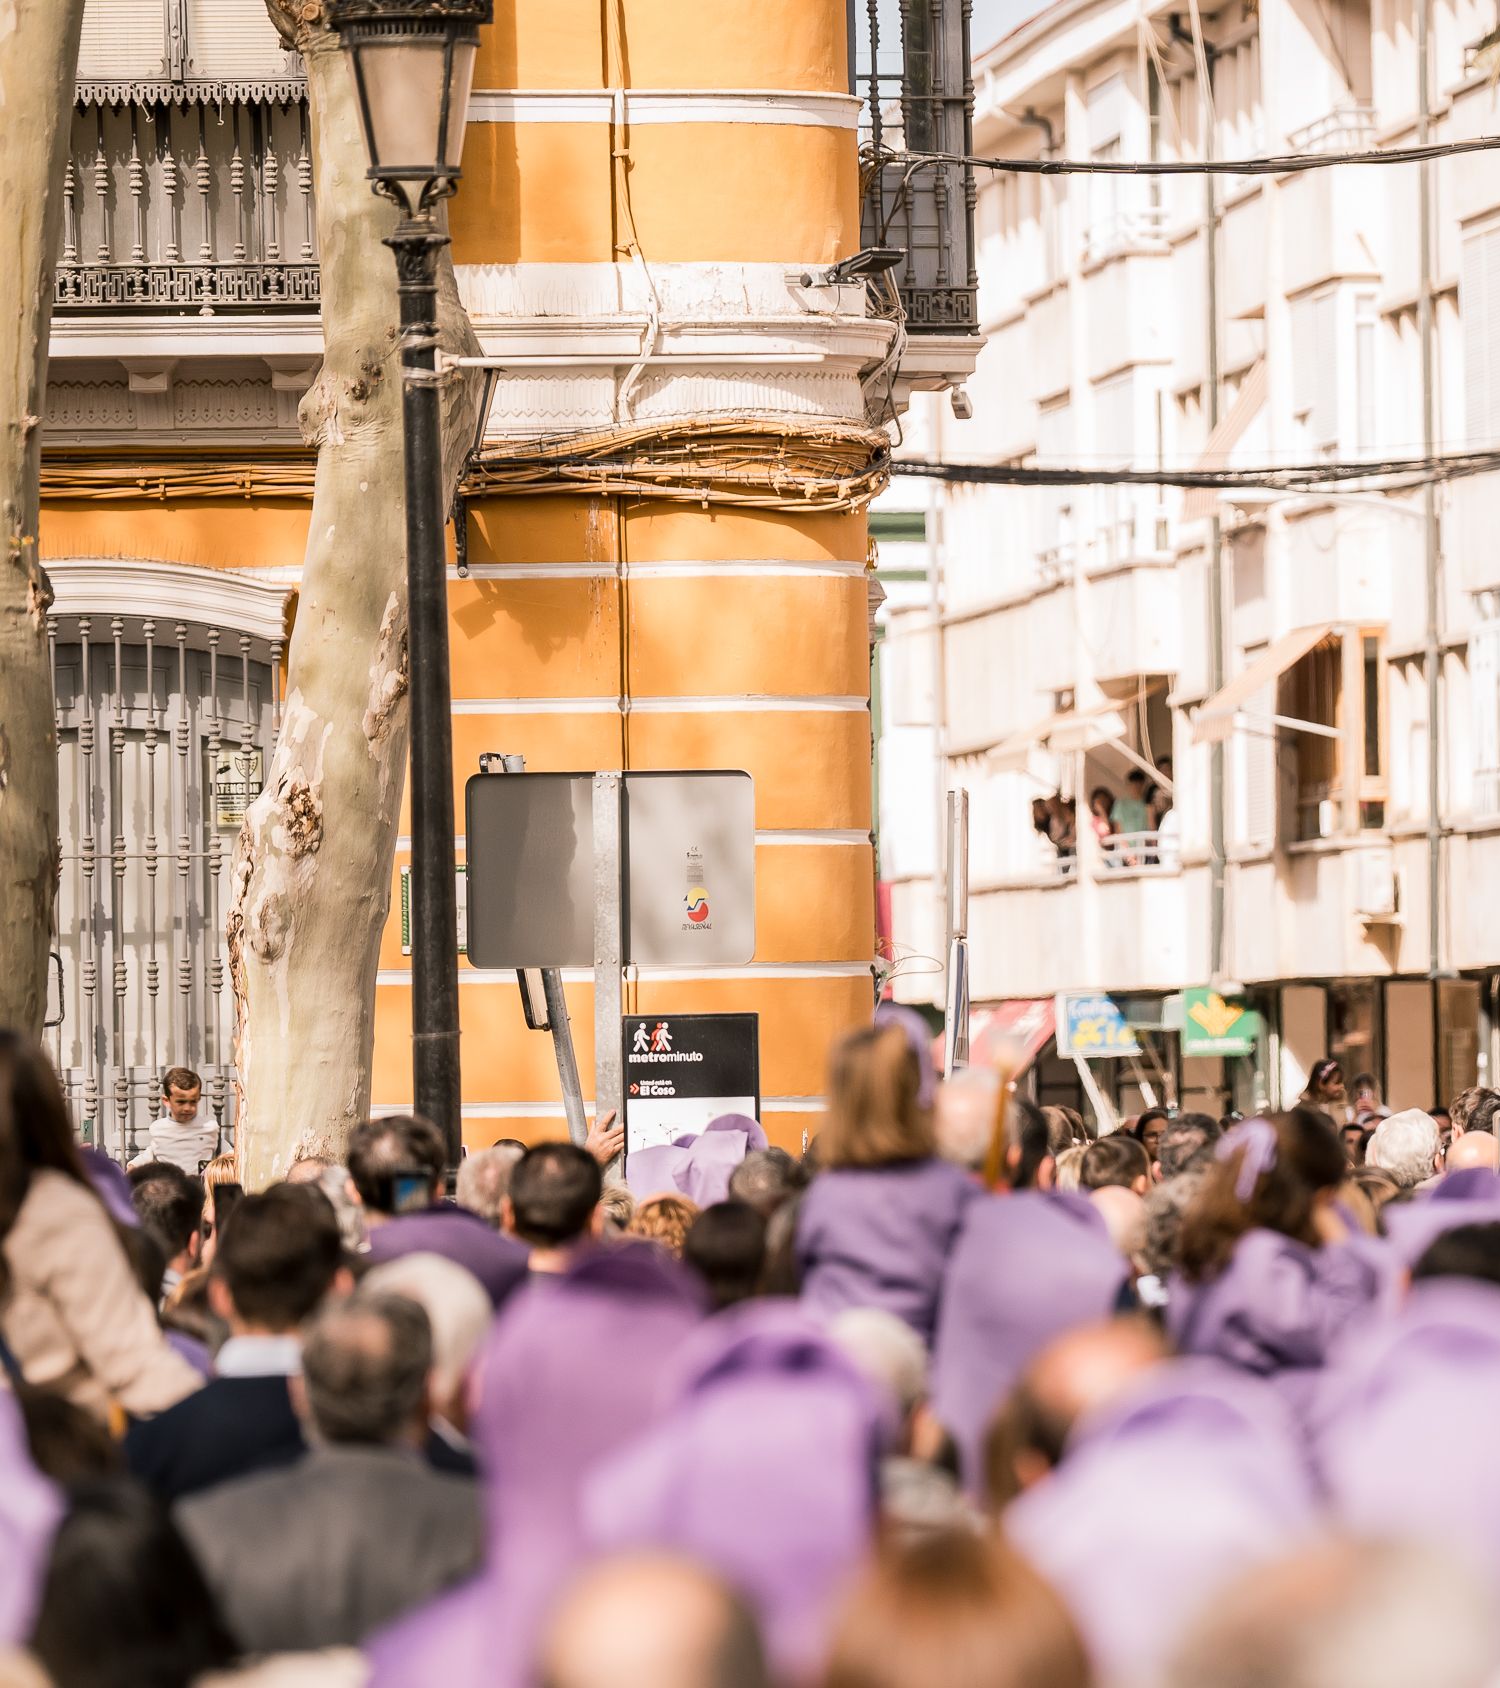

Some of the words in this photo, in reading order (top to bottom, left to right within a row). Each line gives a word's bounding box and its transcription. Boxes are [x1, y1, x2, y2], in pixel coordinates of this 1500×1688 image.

[628, 1051, 703, 1063] metrominuto
[640, 1086, 650, 1096] El
[651, 1086, 676, 1096] Coso
